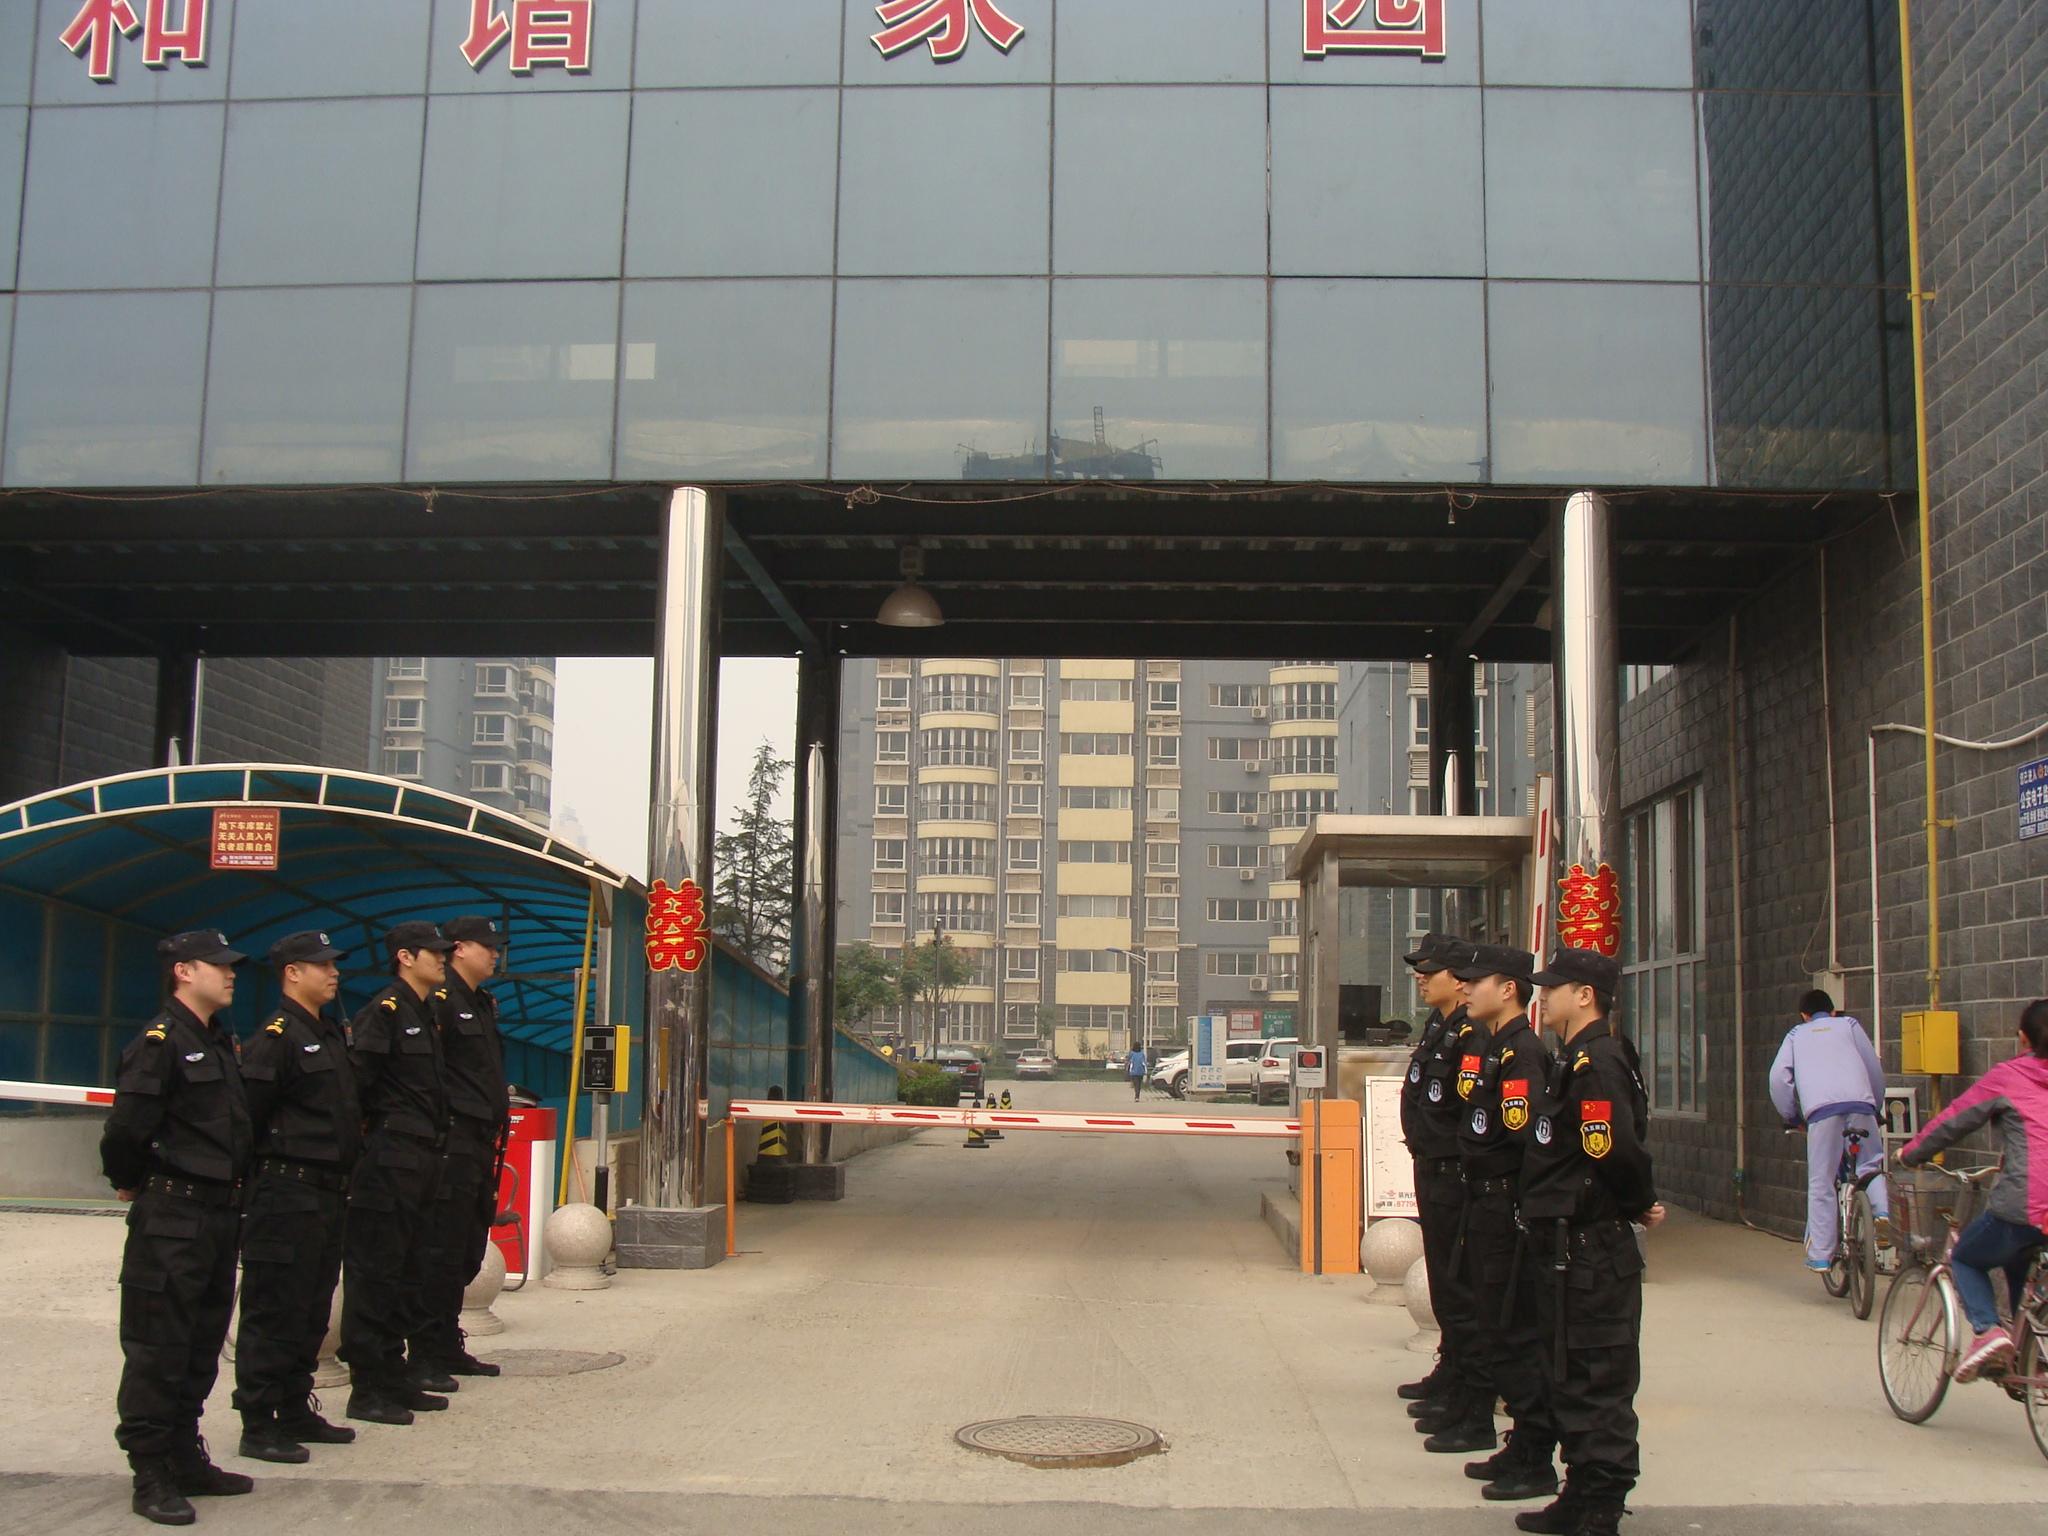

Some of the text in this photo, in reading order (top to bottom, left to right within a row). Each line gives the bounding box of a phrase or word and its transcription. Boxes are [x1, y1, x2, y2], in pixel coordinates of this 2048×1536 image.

[218, 821, 274, 831] 地下车库禁止
[217, 831, 273, 841] 无关人员入内
